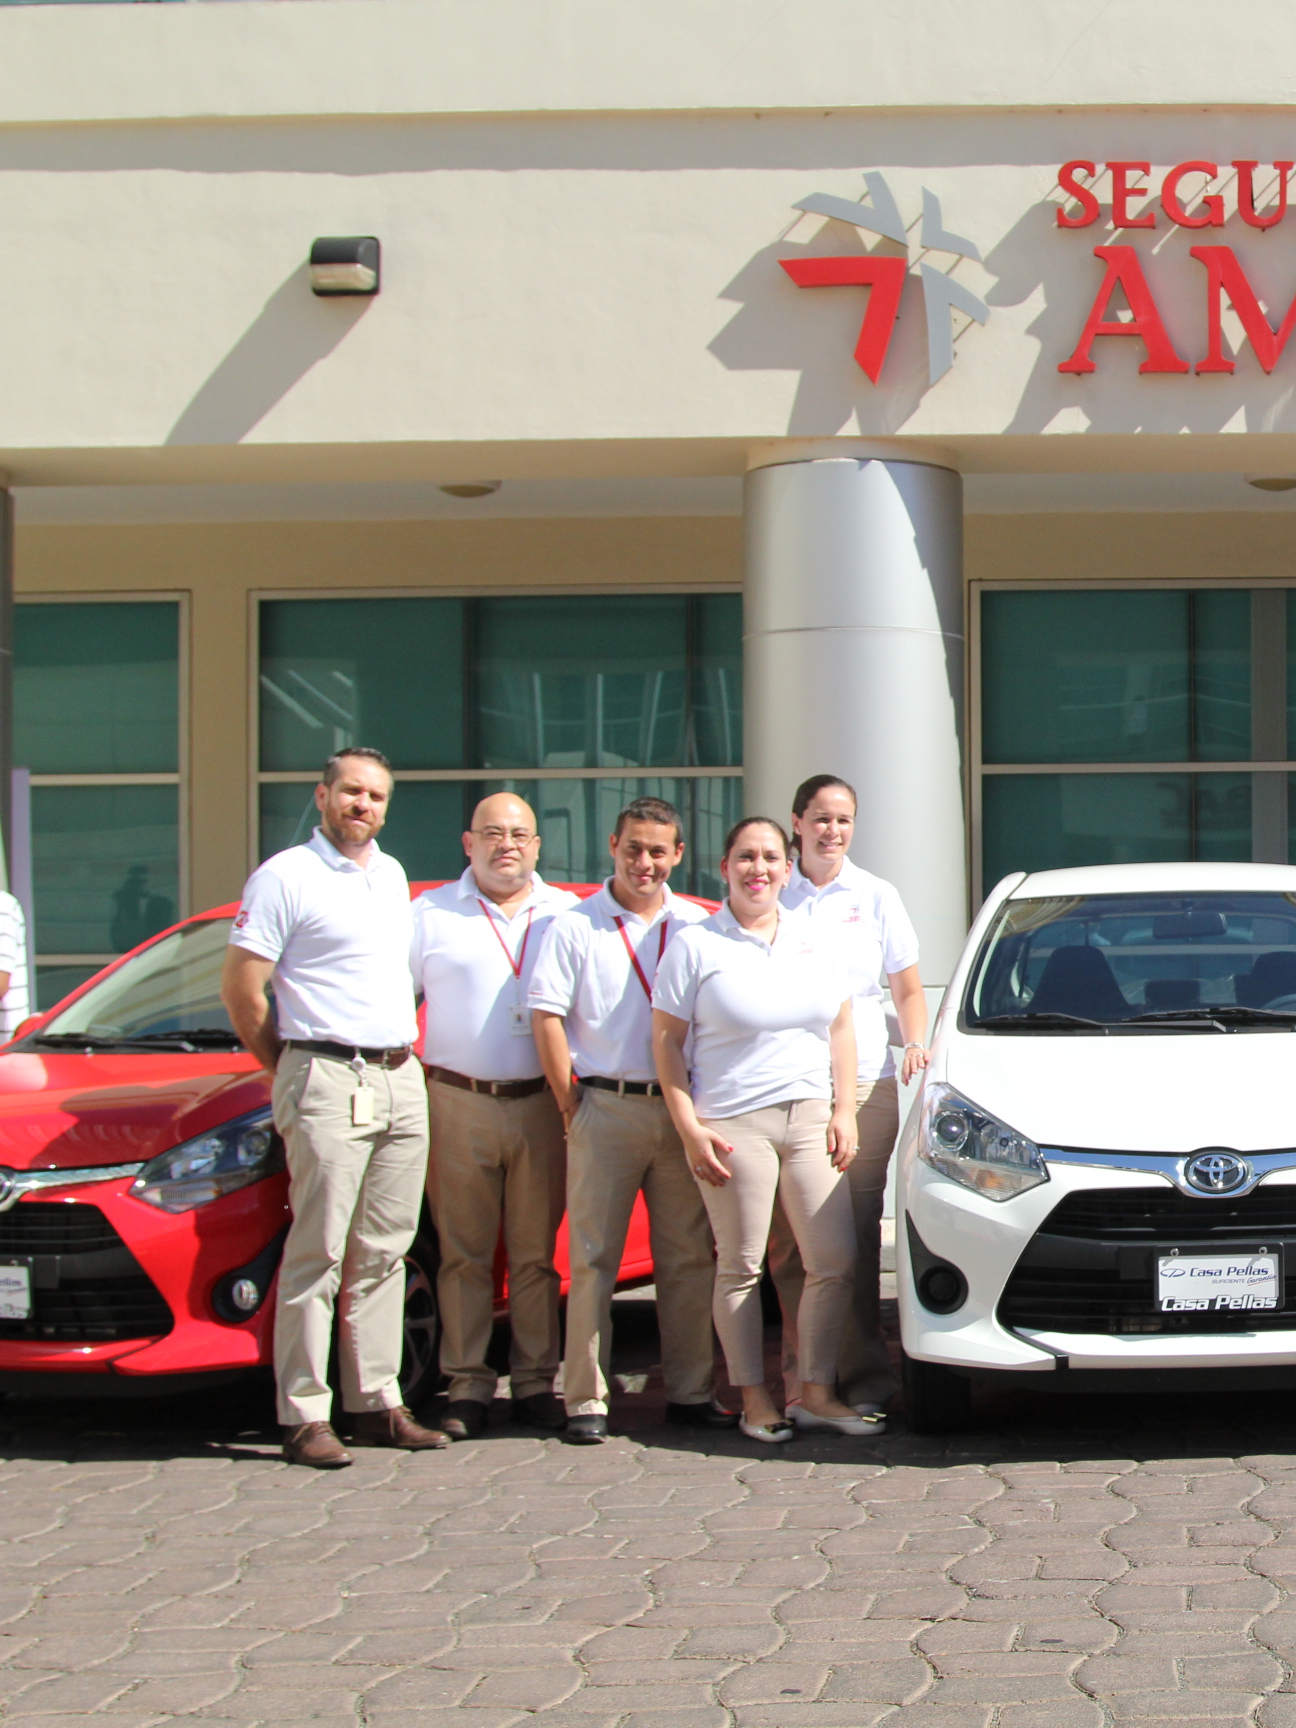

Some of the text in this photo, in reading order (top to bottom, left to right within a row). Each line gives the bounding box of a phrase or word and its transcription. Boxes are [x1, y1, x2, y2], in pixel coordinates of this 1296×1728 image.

[1190, 1266, 1269, 1277] Casa Pellas
[1161, 1294, 1277, 1311] Casa Pellas
